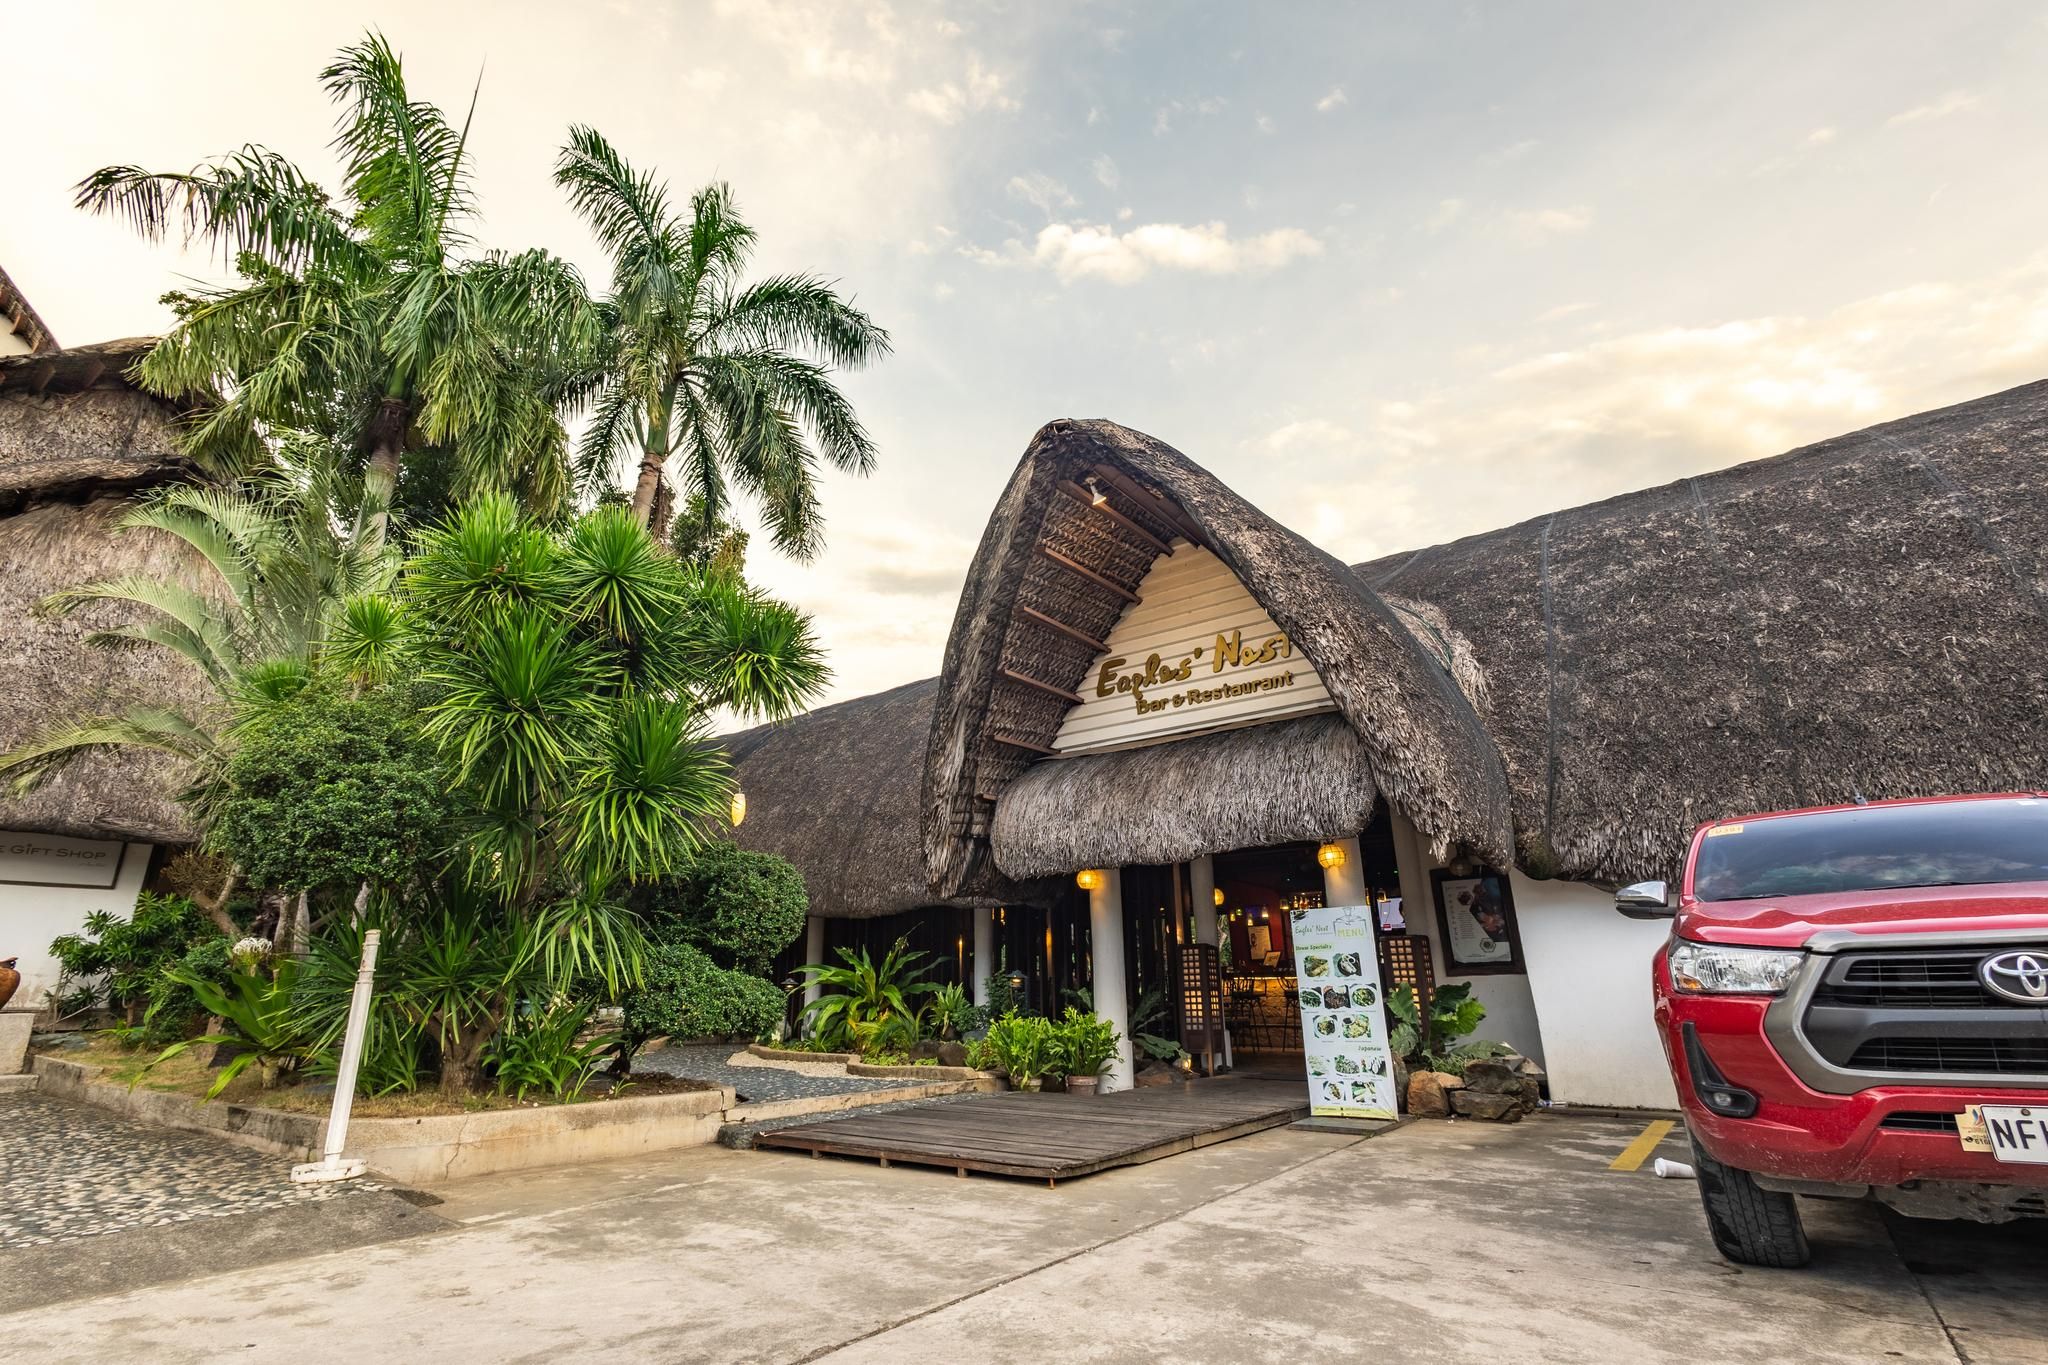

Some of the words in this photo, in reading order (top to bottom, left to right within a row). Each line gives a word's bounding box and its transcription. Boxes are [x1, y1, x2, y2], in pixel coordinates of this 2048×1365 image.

[1096, 647, 1203, 700] Eagles'
[1135, 697, 1170, 716] Bar
[1172, 694, 1185, 708] &
[1186, 670, 1295, 706] Restaurant
[1337, 927, 1365, 937] MENU
